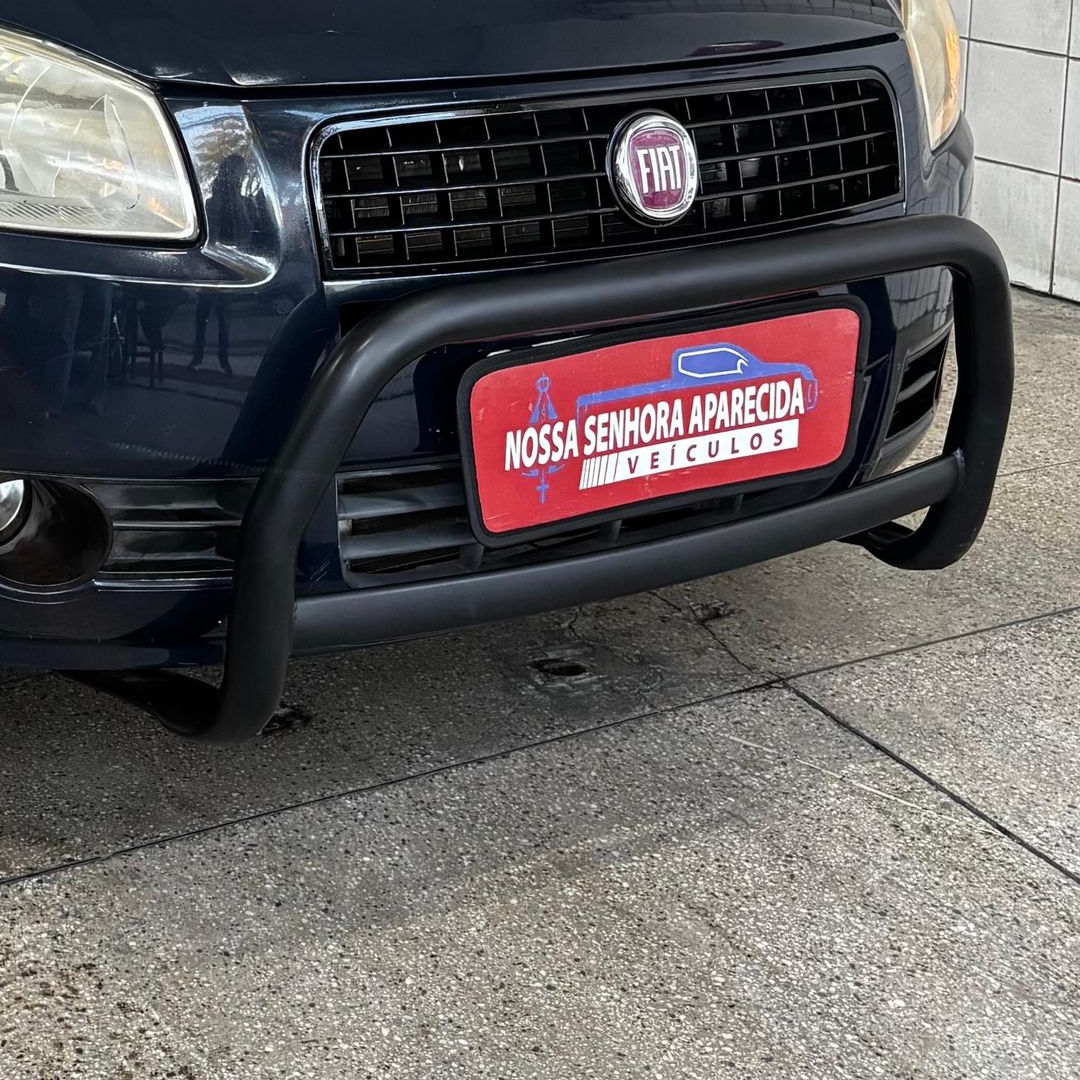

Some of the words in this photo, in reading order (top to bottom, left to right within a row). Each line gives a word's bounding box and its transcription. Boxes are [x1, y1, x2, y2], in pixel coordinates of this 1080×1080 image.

[636, 144, 682, 194] FIAT
[504, 419, 579, 472] NOSSA
[583, 398, 684, 456] SENHORA
[688, 377, 805, 435] APARECIDA
[626, 428, 784, 475] VEÍCULOS
